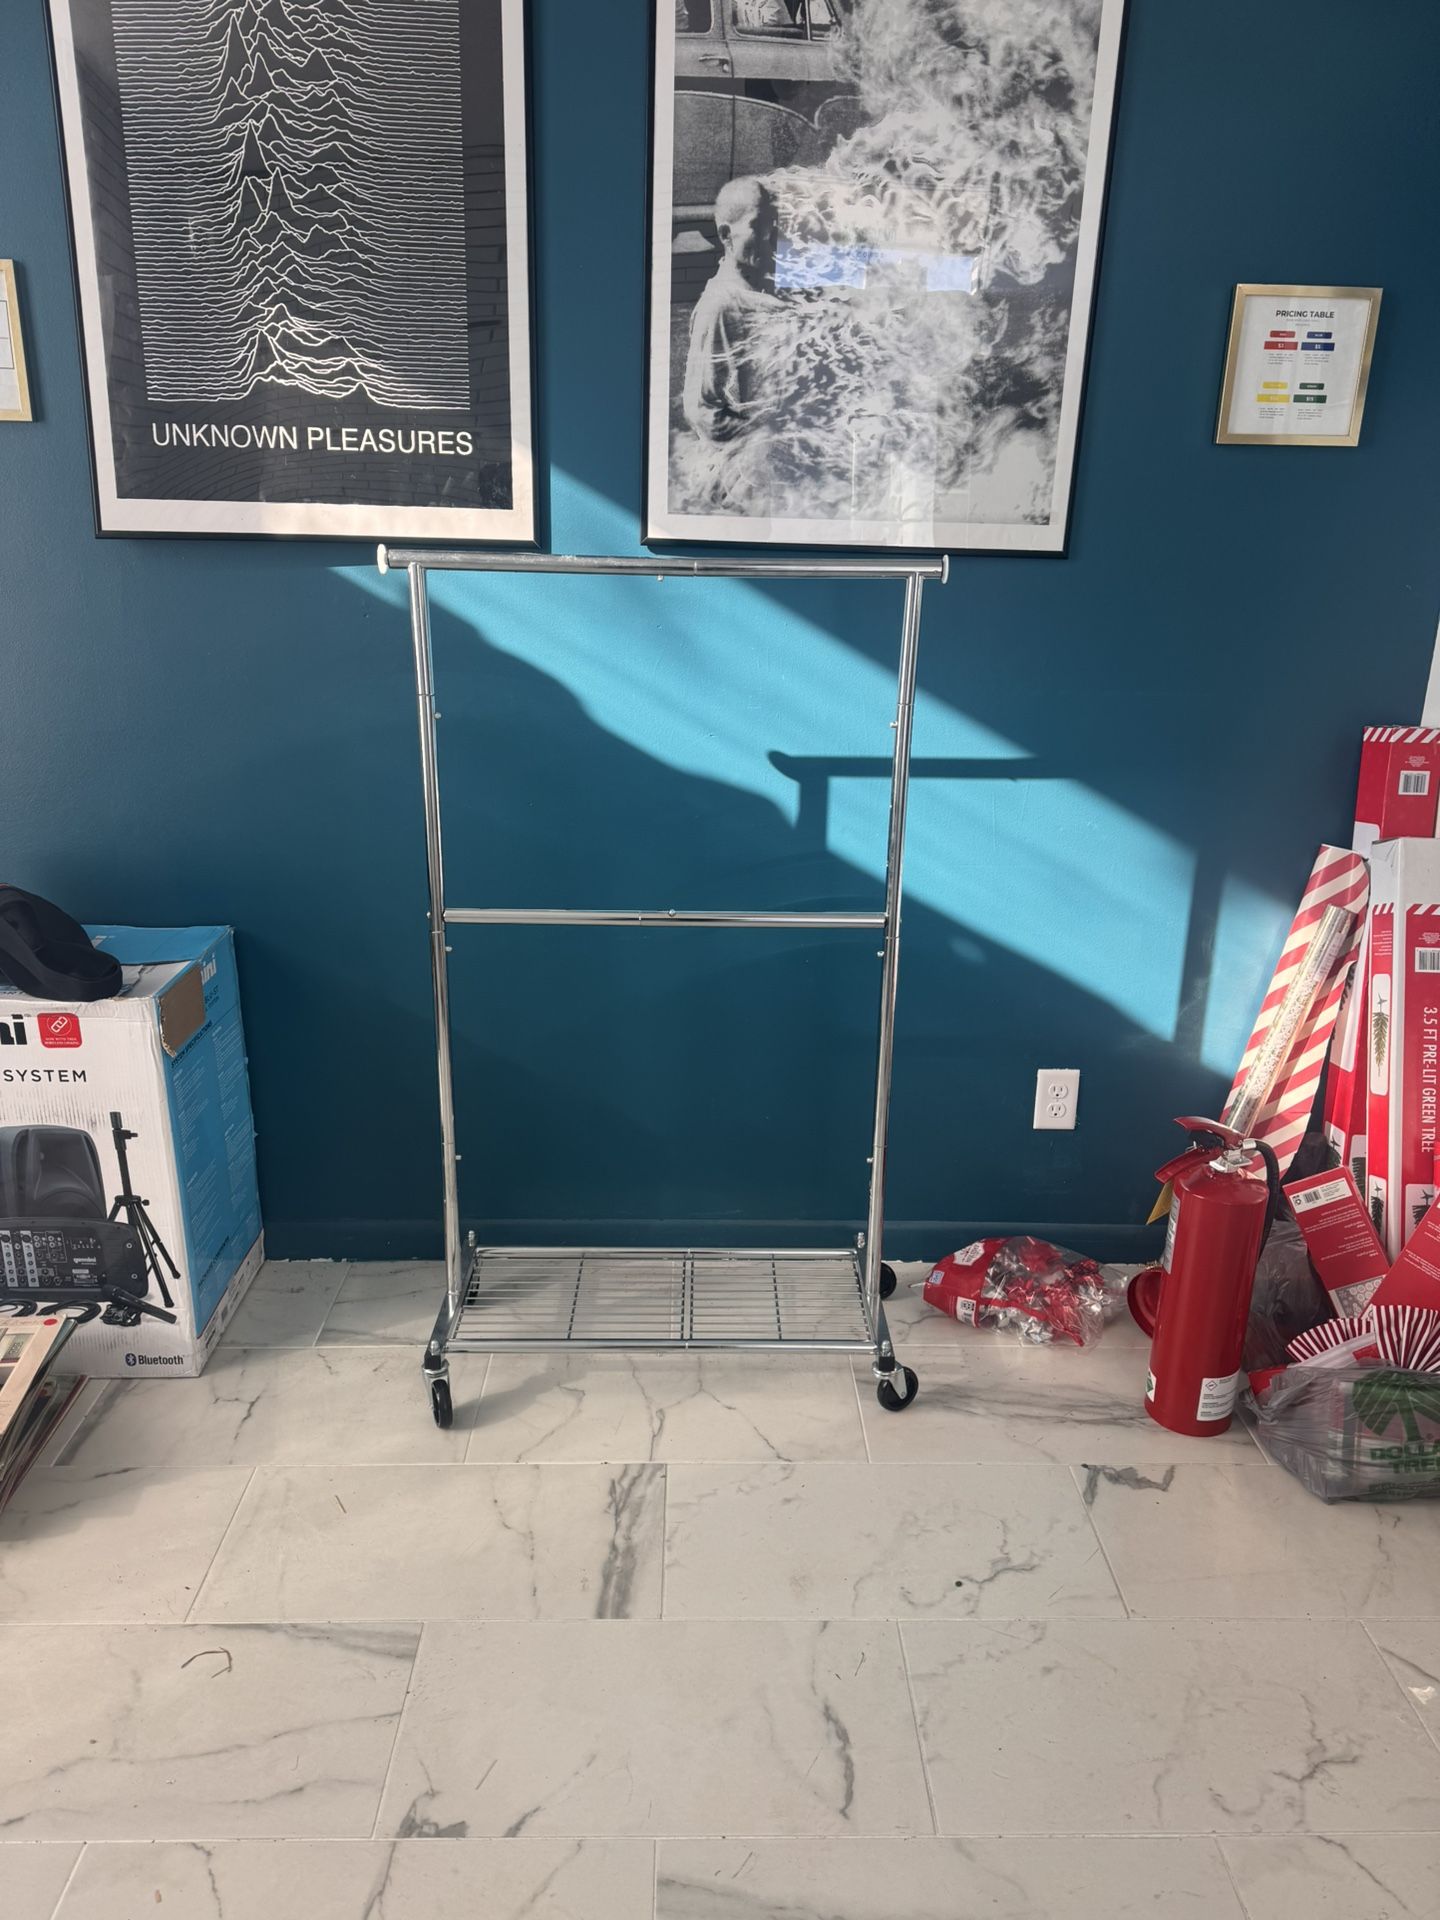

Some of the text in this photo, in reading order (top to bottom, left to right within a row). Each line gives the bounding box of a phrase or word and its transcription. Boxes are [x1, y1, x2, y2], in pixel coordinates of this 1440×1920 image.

[1275, 309, 1335, 319] PRICING TABLE
[151, 422, 474, 455] UNKNOWN PLEASURES
[1423, 1006, 1438, 1025] 3.5
[1423, 1028, 1438, 1043] FT
[1422, 1044, 1437, 1085] PRE-LIT
[3, 1069, 87, 1083] SYSTEM
[1421, 1087, 1437, 1125] GREEN
[138, 1354, 184, 1365] Bluetooth
